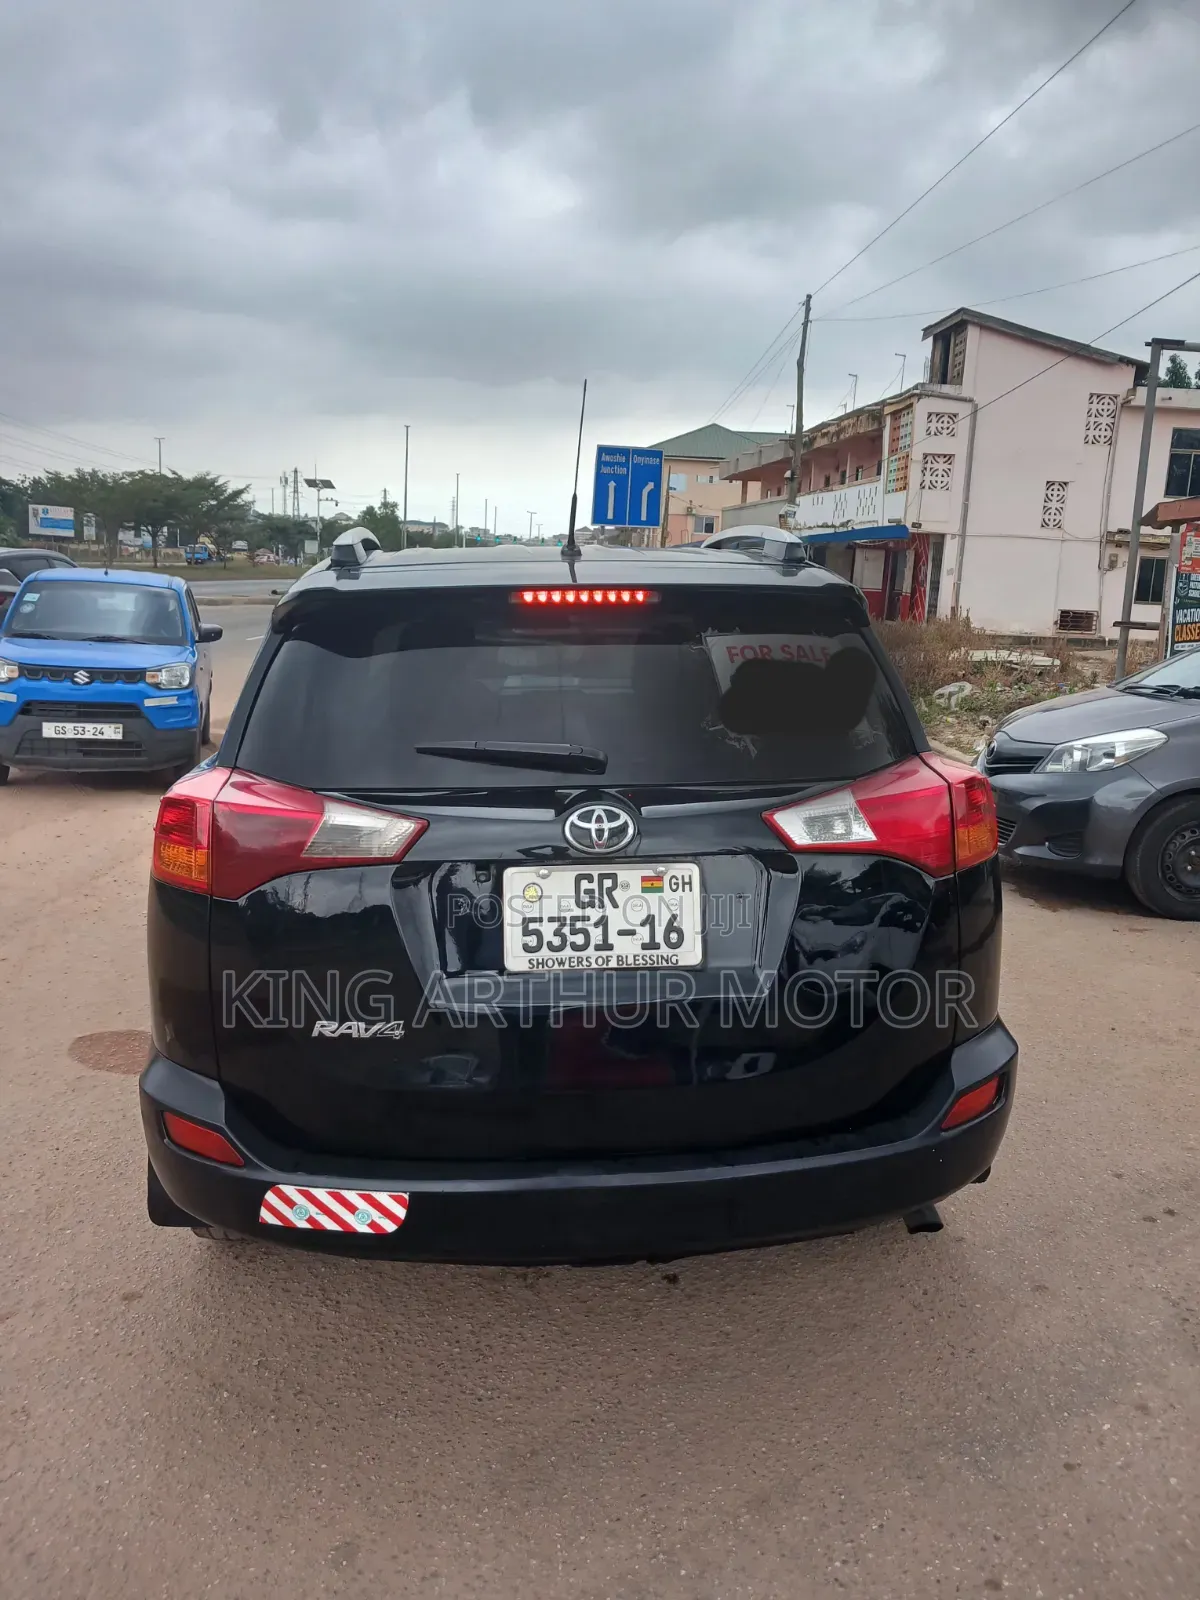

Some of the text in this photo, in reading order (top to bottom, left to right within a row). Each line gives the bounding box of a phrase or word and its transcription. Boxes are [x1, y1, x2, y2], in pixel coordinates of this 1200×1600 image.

[601, 452, 626, 463] Awoshie
[633, 454, 660, 466] Onyinase
[600, 464, 627, 475] Junction
[725, 644, 773, 664] FOR
[54, 725, 67, 735] GS
[73, 726, 105, 736] 53-24
[574, 872, 693, 910] GR GH
[521, 913, 685, 954] 5351-16
[528, 954, 679, 970] SHOWERS OF BLESSING
[311, 1020, 405, 1039] RAV4
